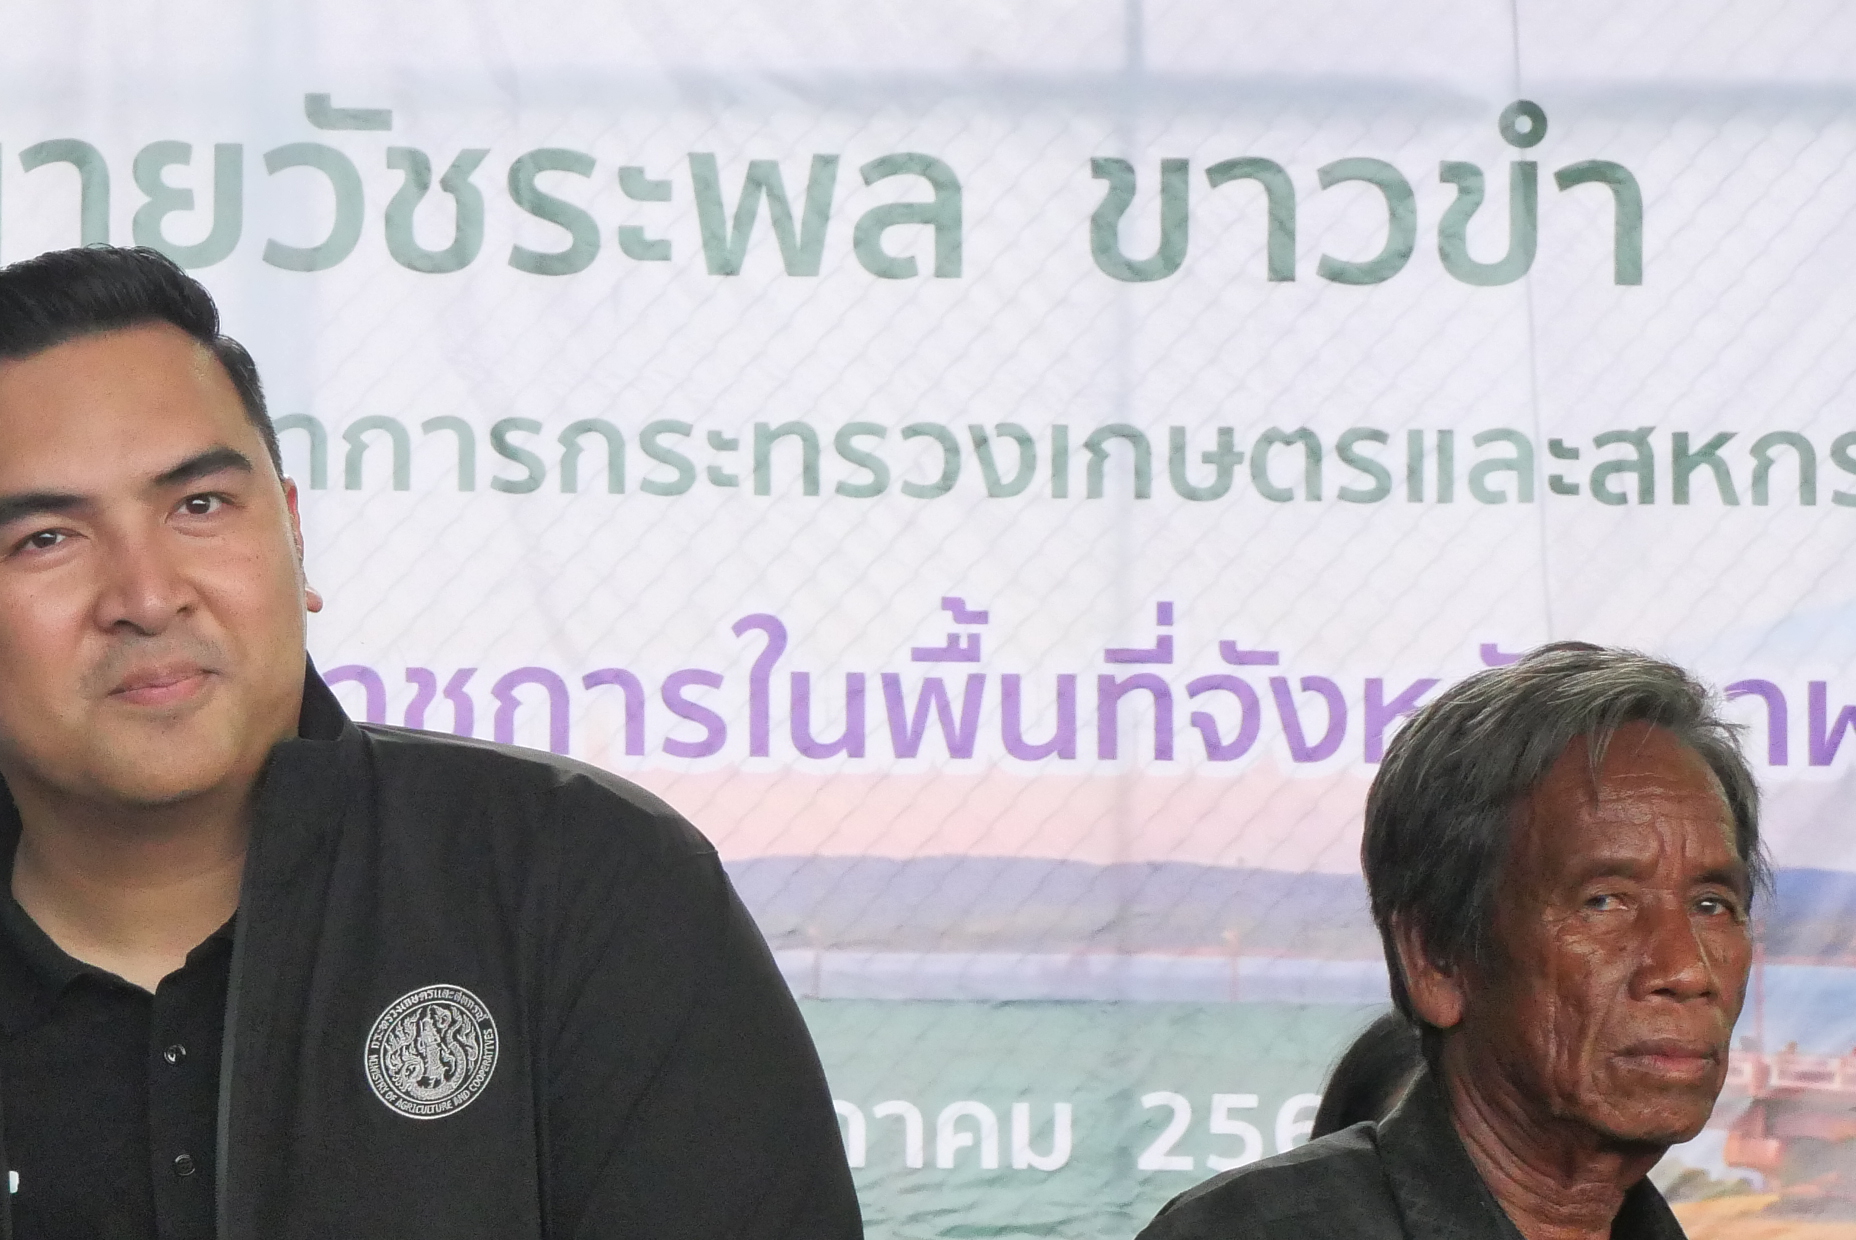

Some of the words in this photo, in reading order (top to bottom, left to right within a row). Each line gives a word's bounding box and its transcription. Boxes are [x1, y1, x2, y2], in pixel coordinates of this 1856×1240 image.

[1089, 99, 1644, 287] ขาวขำ
[367, 1054, 391, 1095] MINISTRY
[384, 1090, 398, 1102] OF
[394, 1098, 454, 1115] AGRICULTURE
[453, 1089, 471, 1107] AND
[468, 1028, 495, 1092] COOPERATIVES
